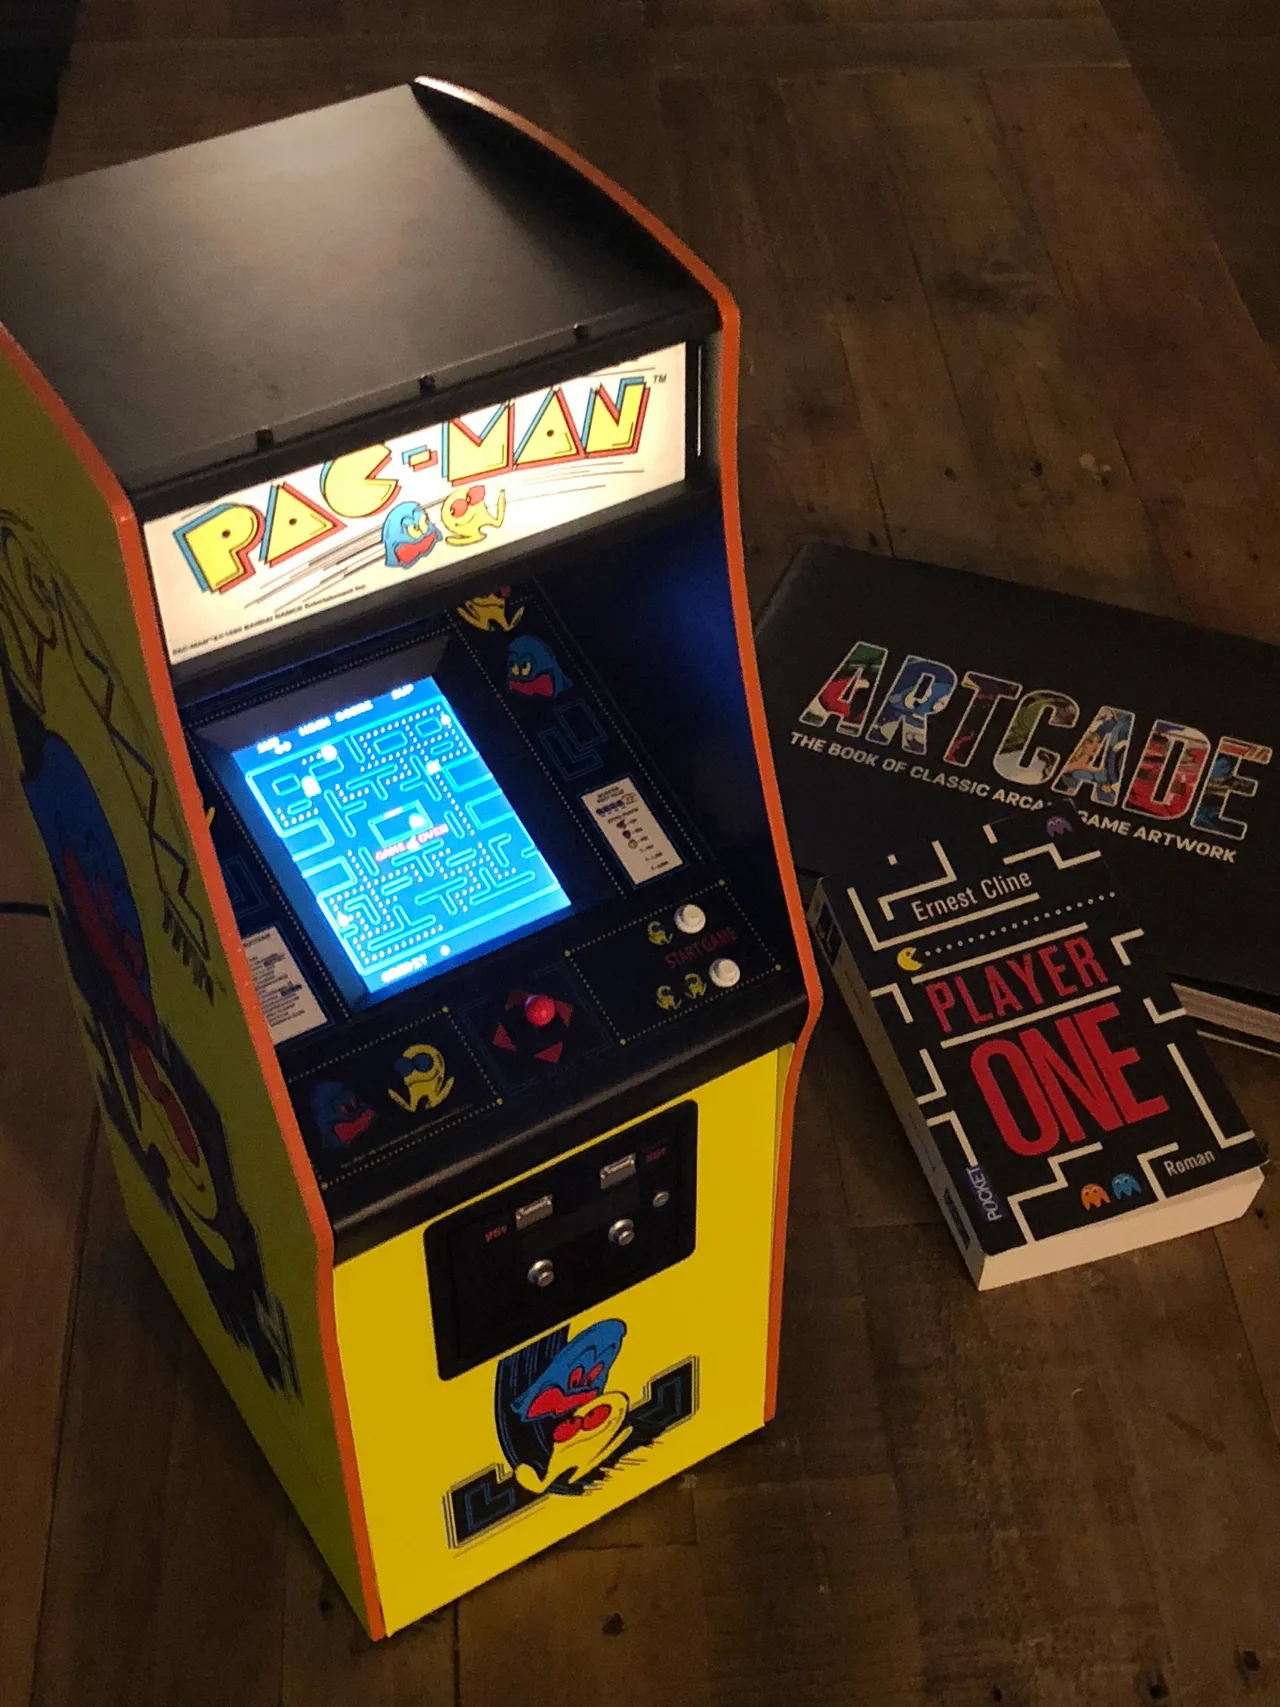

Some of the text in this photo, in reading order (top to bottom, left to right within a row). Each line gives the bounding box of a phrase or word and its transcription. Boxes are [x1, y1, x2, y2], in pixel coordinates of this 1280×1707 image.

[173, 377, 650, 593] PAC-MAN
[799, 641, 1273, 841] ARTCADE
[790, 731, 826, 752] THE
[828, 743, 877, 769] BOOK
[882, 753, 907, 773] OF
[910, 760, 990, 798] CLASSIC
[993, 787, 1052, 812] ARCA
[1132, 824, 1236, 864] ARTWORK
[912, 870, 1033, 922] Ernest Cline
[664, 926, 740, 970] START GAME
[924, 936, 1108, 1034] PLAYER
[970, 1002, 1170, 1156] ONE
[966, 1164, 1003, 1222] POCKET
[1164, 1148, 1216, 1178] Roman
